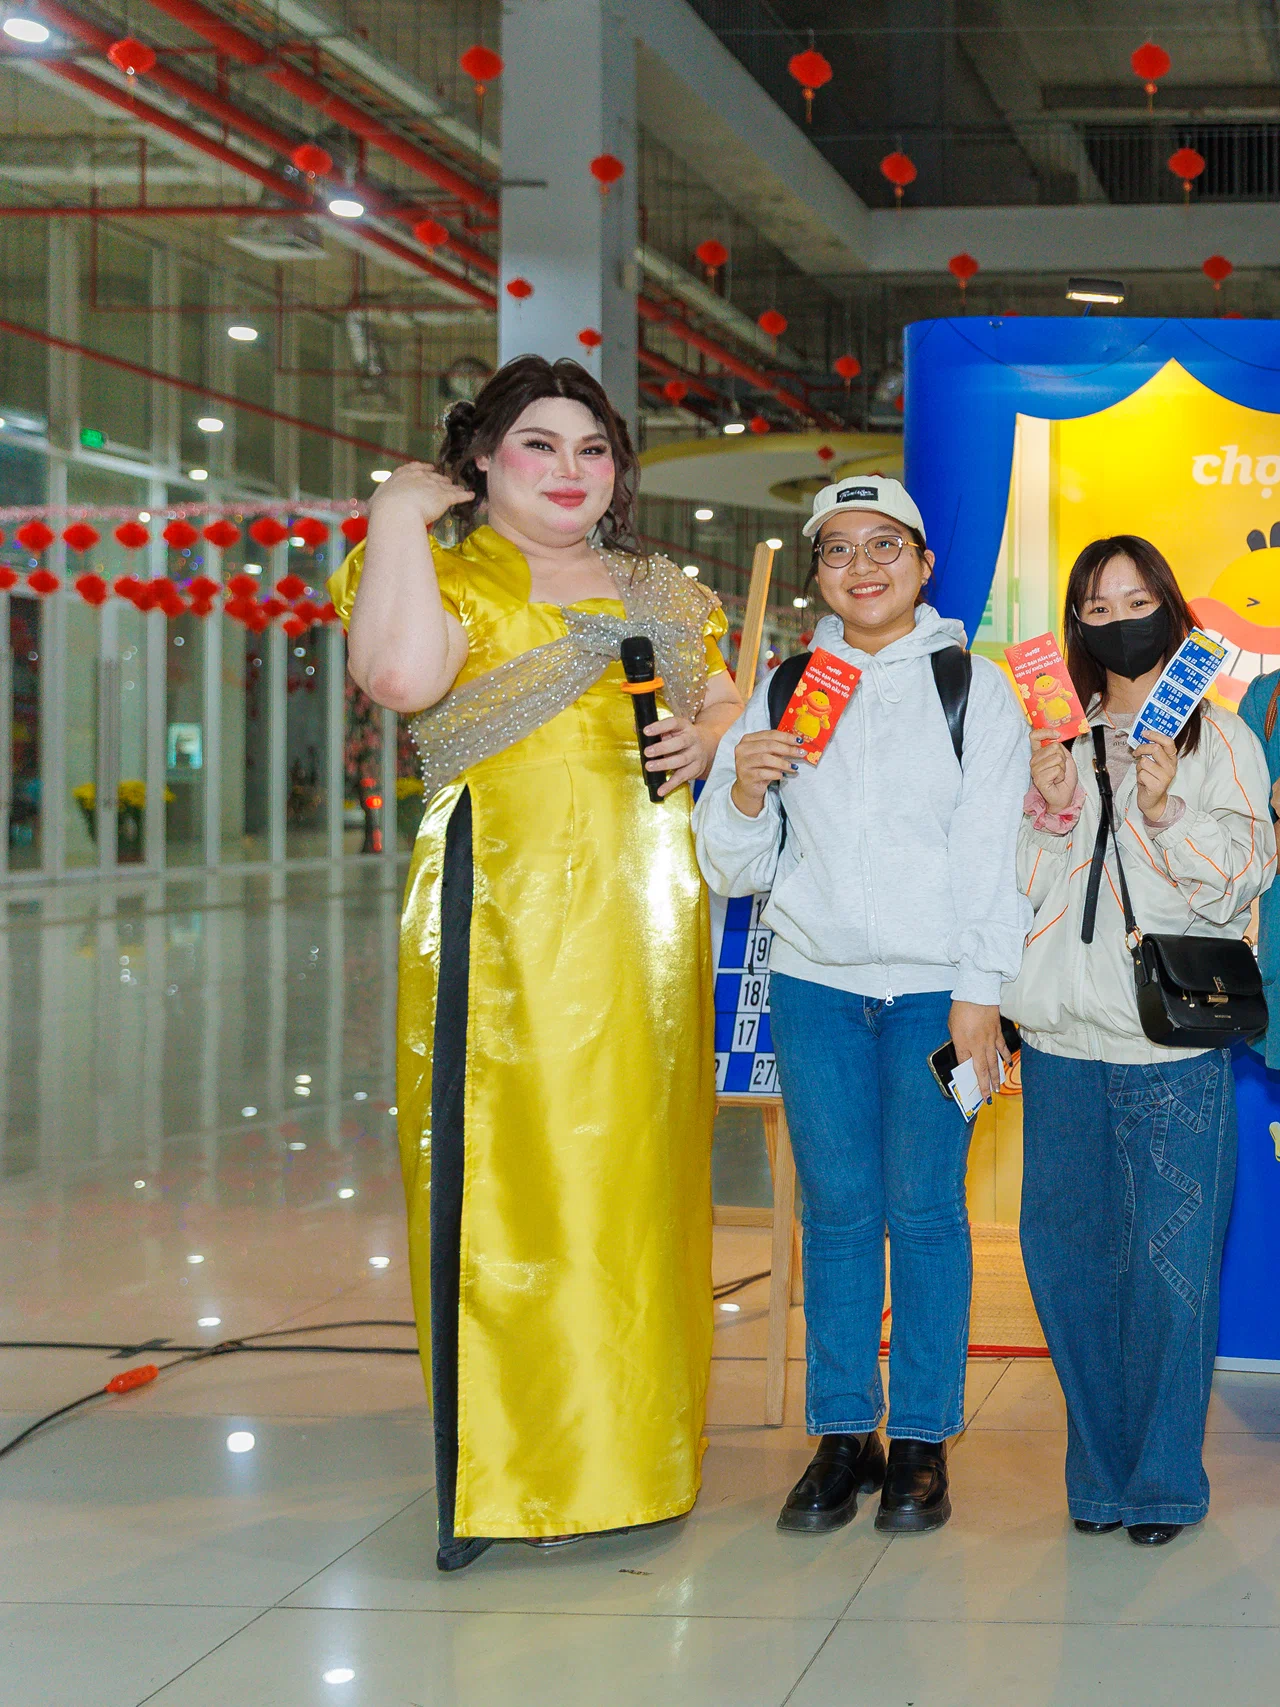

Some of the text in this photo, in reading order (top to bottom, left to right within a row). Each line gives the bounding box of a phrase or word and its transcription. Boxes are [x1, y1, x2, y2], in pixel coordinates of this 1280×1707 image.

[751, 936, 768, 962] 19
[744, 980, 762, 1006] 18
[738, 1020, 756, 1046] 17
[752, 1059, 774, 1086] 27
